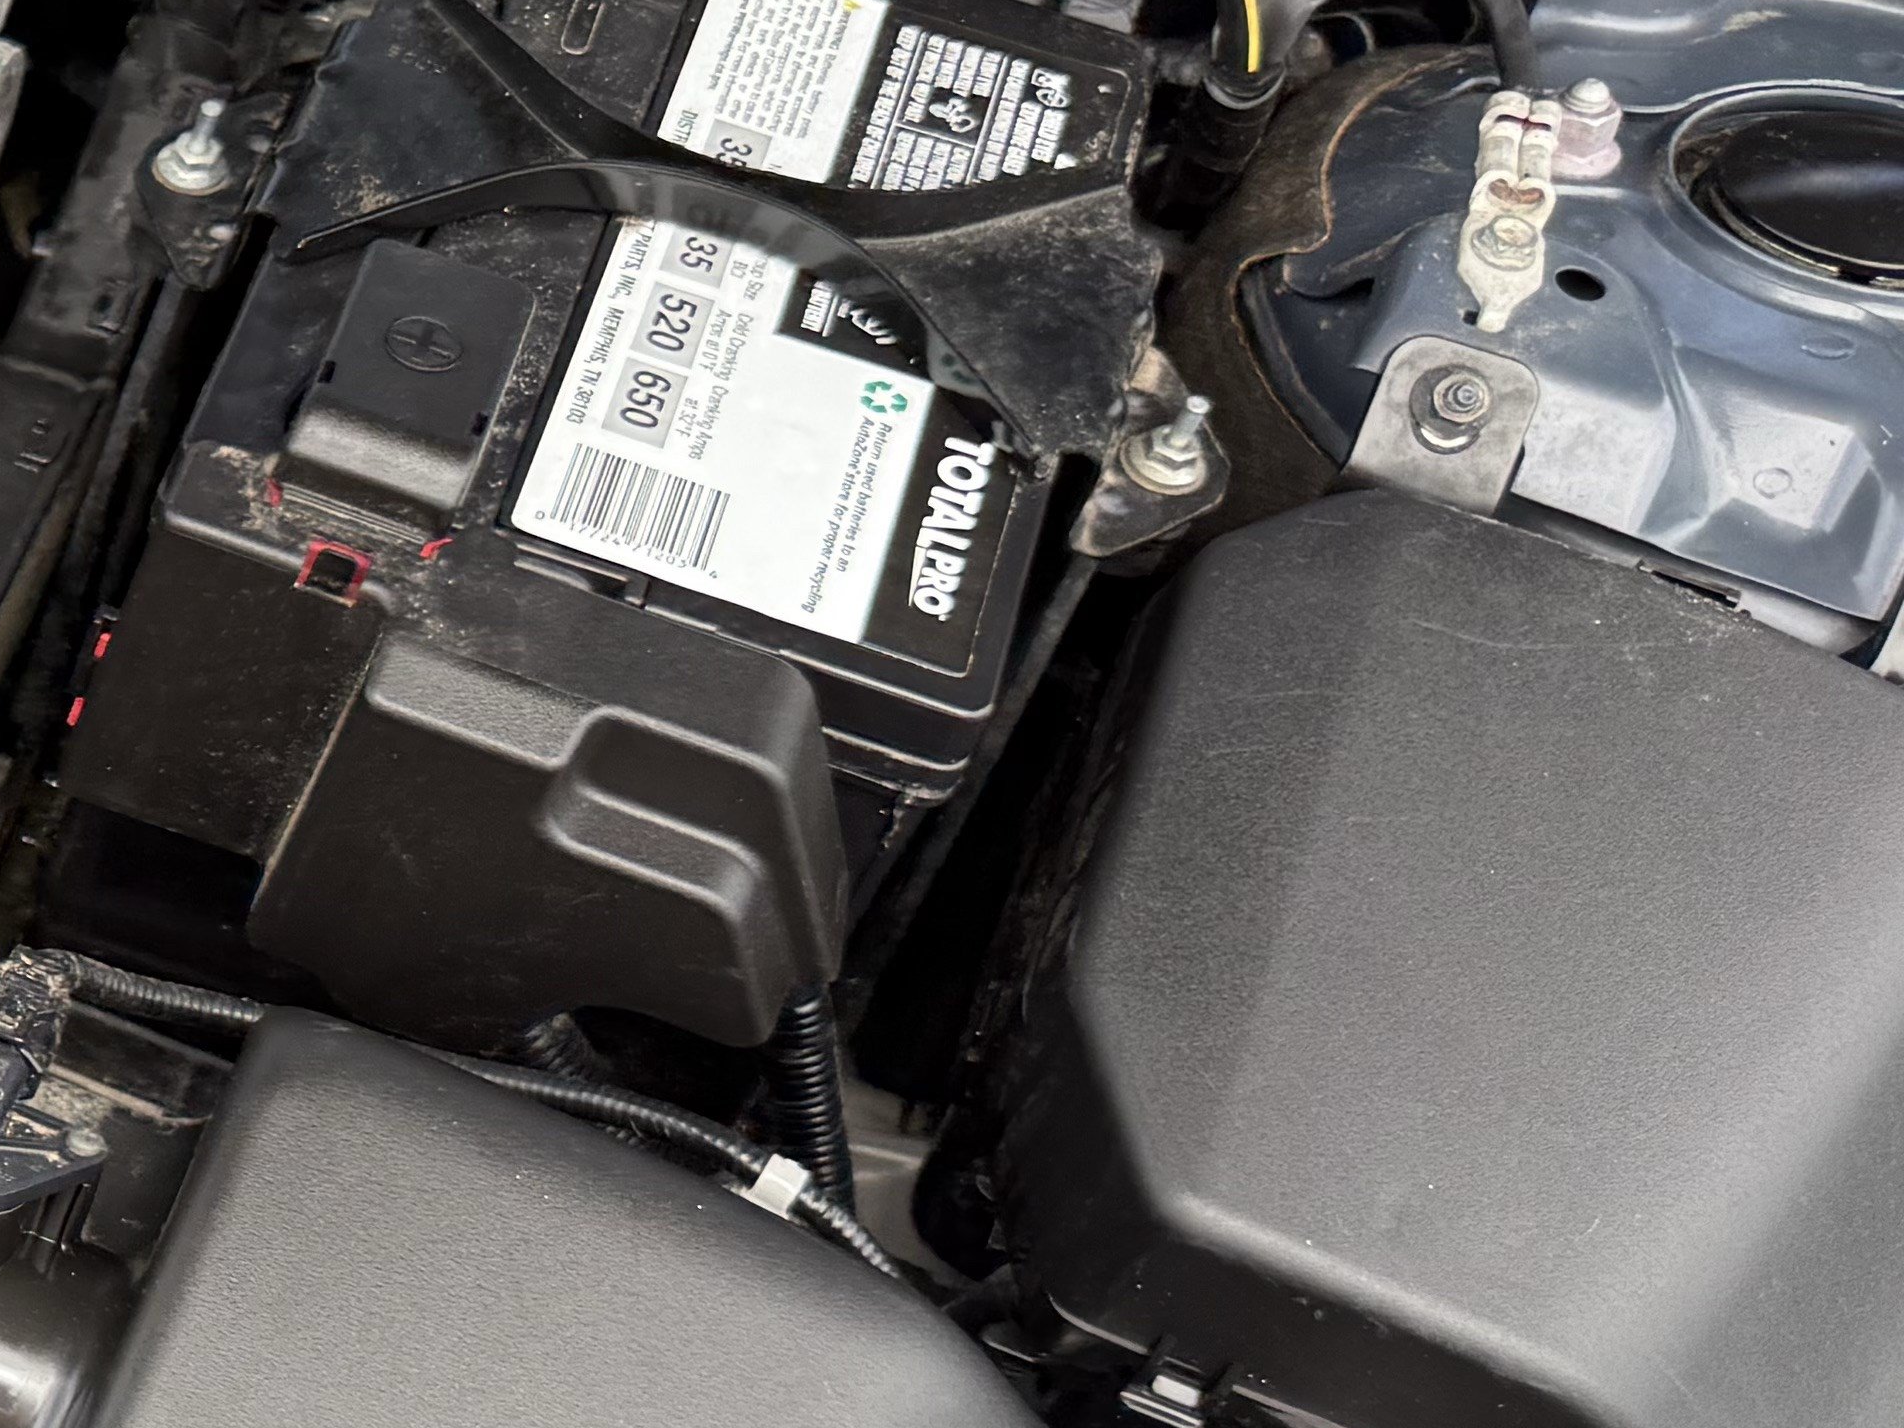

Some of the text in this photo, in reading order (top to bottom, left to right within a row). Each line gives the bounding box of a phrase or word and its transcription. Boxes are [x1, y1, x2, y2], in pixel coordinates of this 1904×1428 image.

[620, 232, 652, 271] PARTS,
[680, 236, 718, 273] 35
[583, 306, 625, 364] MEMPHIS,
[646, 293, 698, 352] 520
[713, 312, 754, 382] Cold Cranking
[580, 369, 601, 386] TN
[619, 370, 672, 429] 650
[566, 386, 594, 425] 38103
[688, 385, 729, 461] Cranking Amps
[836, 422, 892, 573] Return used batteries to an
[838, 471, 856, 501] store
[833, 503, 849, 521] for
[821, 520, 840, 560] proper
[800, 561, 826, 614] recycling
